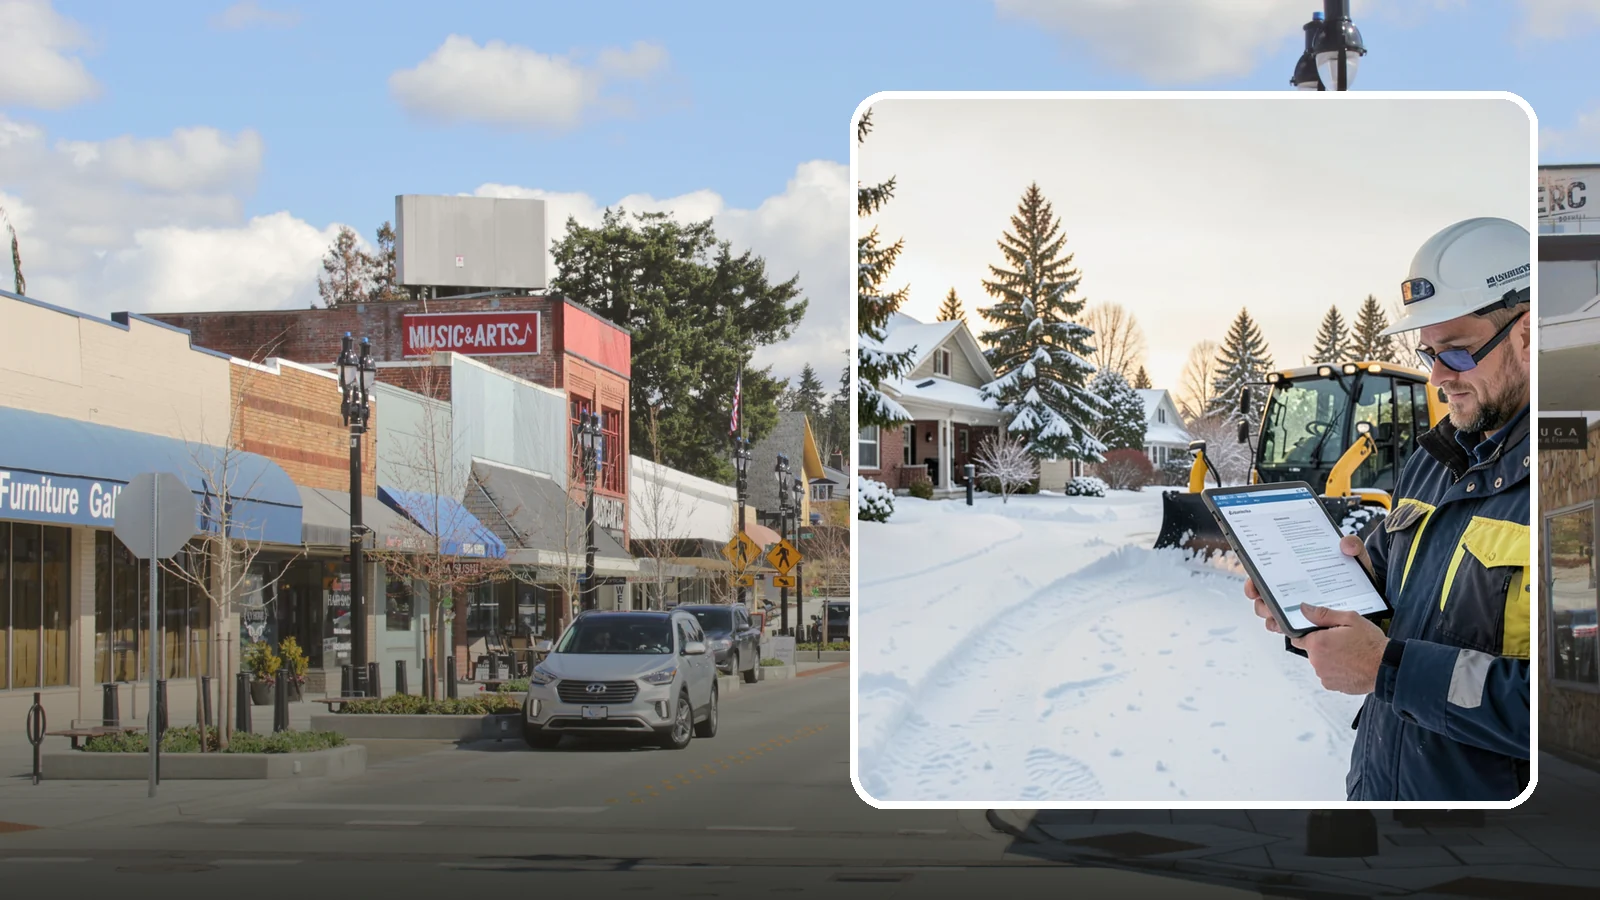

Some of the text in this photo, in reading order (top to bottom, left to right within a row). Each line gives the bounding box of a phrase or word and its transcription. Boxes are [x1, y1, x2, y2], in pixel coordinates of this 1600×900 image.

[409, 323, 519, 349] MUSIC&ARTS
[1540, 427, 1577, 436] UGA
[0, 472, 121, 519] Furniture Gal
[453, 563, 479, 574] SUSHI
